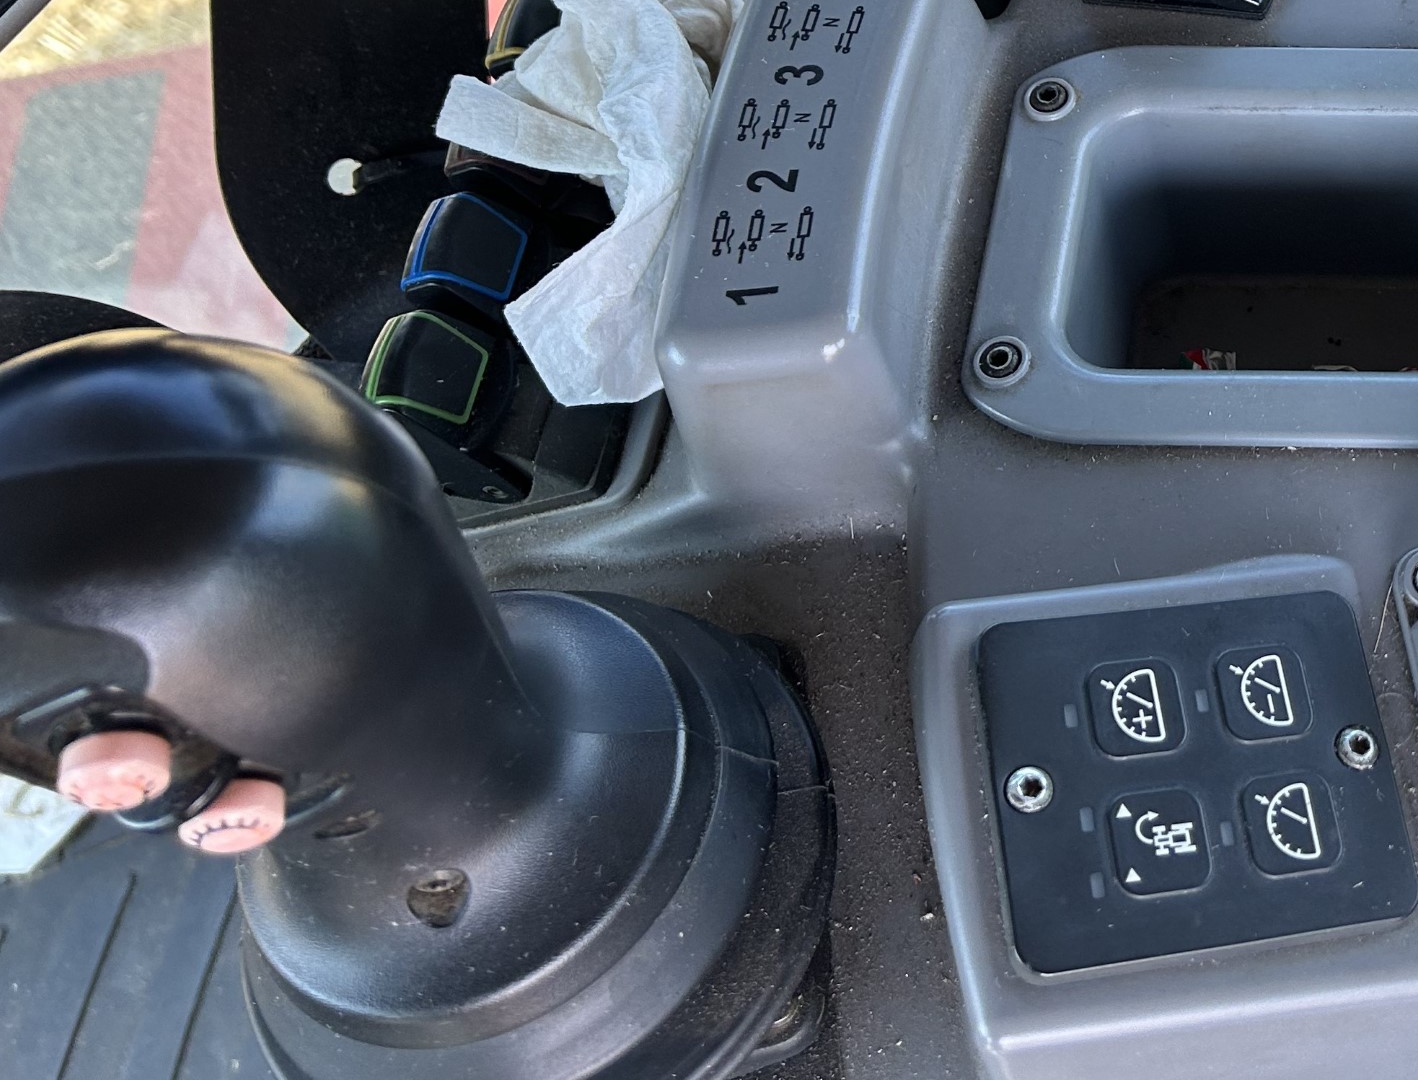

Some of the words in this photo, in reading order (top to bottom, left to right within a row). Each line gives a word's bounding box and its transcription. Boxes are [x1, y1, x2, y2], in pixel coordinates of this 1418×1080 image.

[823, 18, 840, 27] N
[775, 65, 823, 86] 3
[794, 114, 811, 122] N
[747, 170, 799, 192] 2
[770, 223, 788, 233] N
[726, 286, 778, 305] 1
